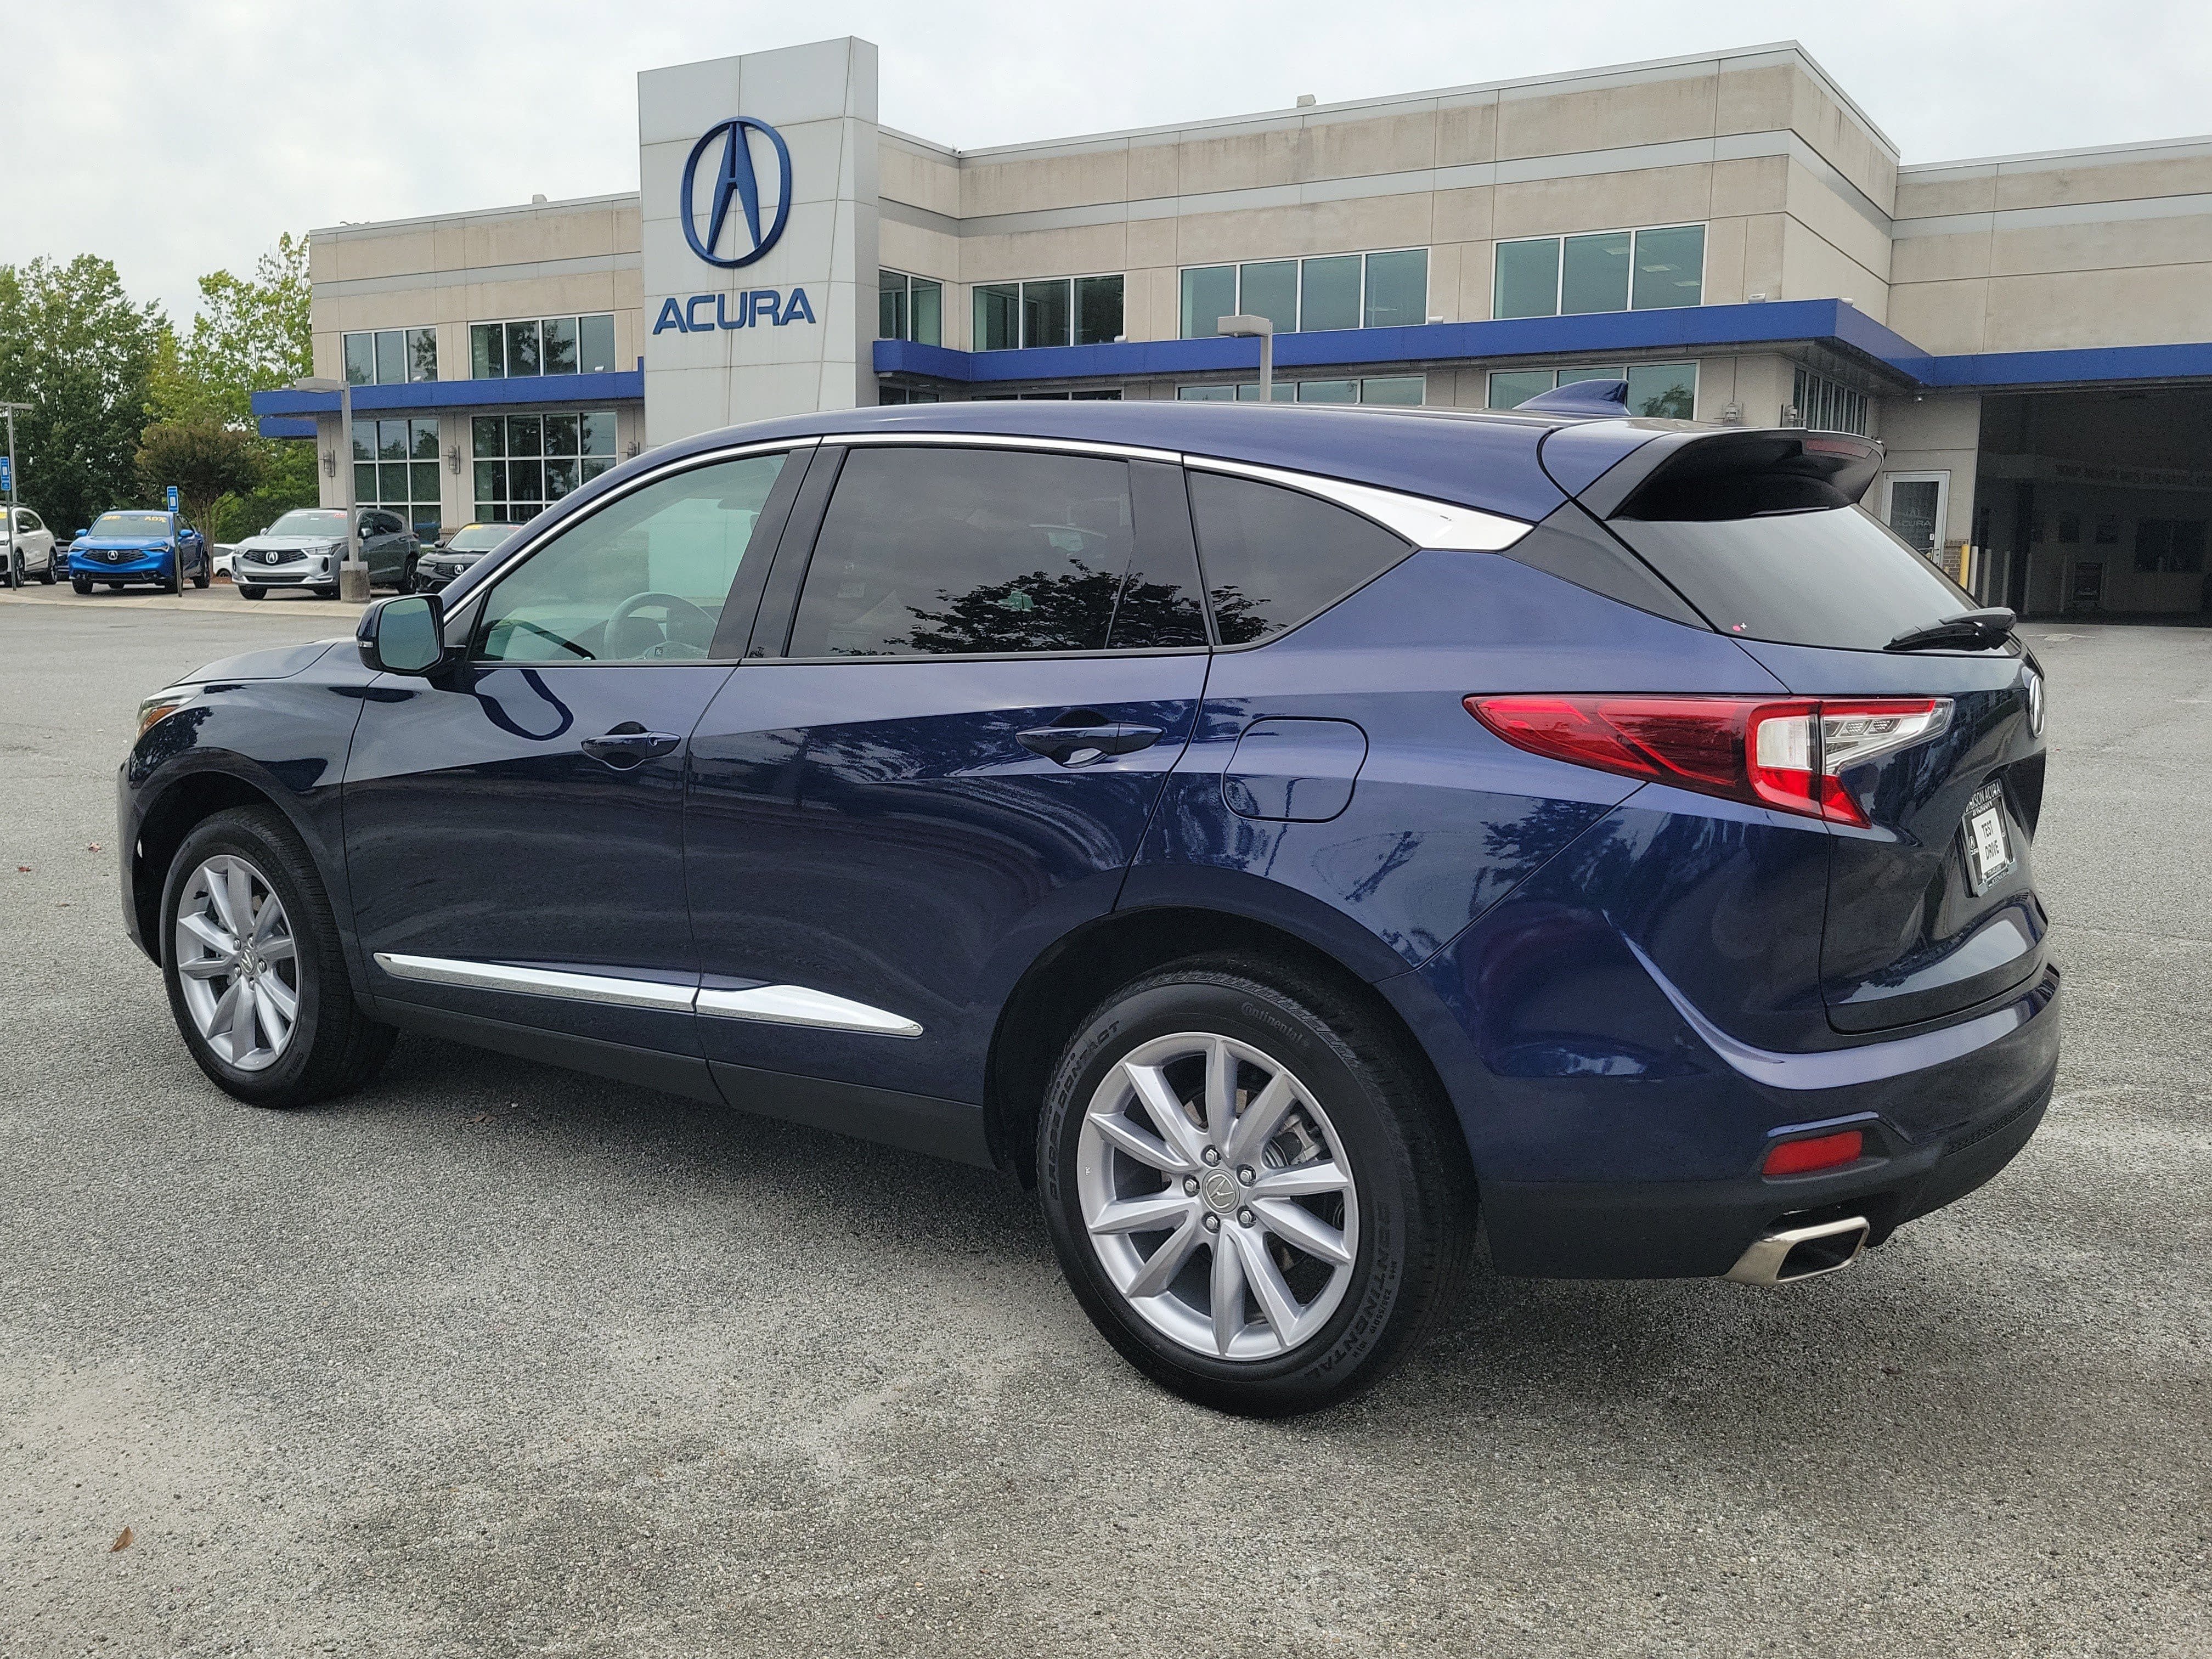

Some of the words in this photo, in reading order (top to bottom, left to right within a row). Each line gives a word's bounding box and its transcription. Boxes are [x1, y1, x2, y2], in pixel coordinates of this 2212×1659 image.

[652, 287, 816, 335] ACURA
[1982, 820, 1994, 839] TEST
[1985, 839, 2000, 860] DRIVE
